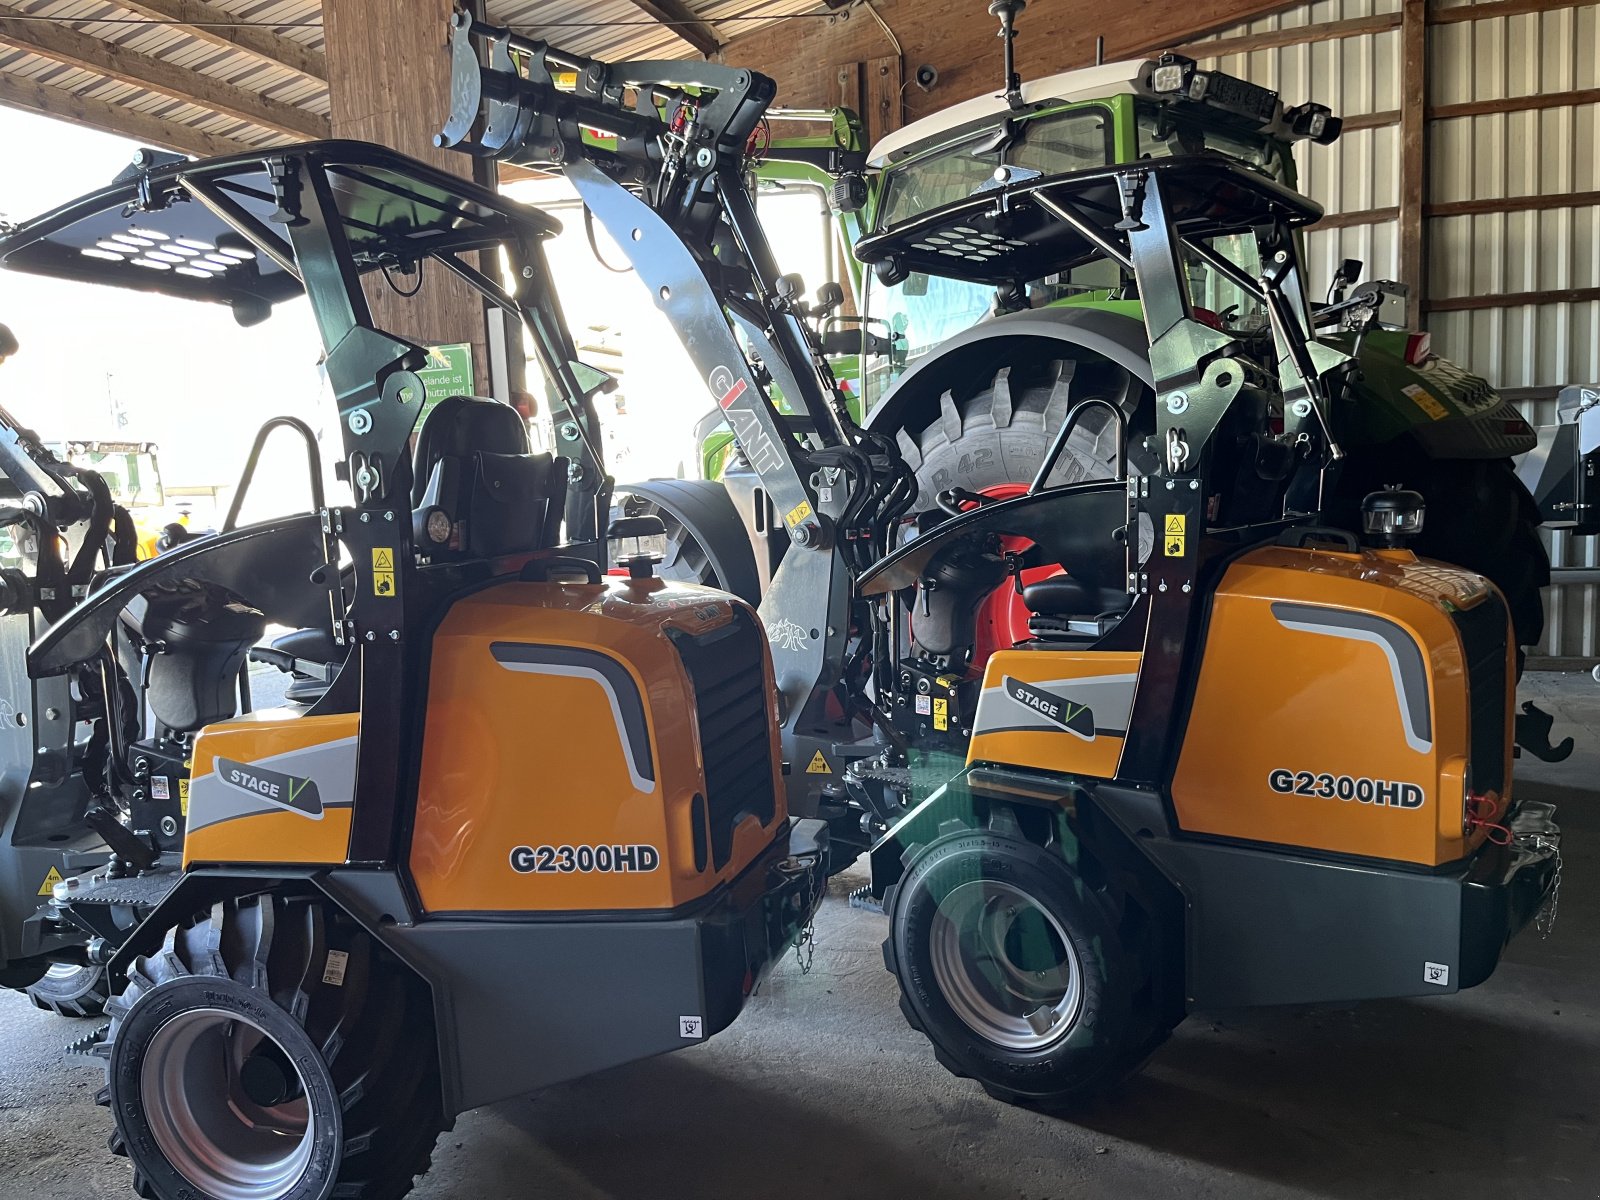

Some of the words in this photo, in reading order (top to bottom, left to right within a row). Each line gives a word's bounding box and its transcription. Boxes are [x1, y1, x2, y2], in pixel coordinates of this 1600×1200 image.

[425, 354, 453, 369] UNG
[449, 385, 466, 396] und
[452, 374, 463, 384] ist
[708, 365, 785, 476] GIANT
[957, 448, 994, 474] 42
[1015, 688, 1059, 718] STAGE
[1065, 702, 1088, 723] V
[230, 769, 280, 798] STAGE
[288, 776, 311, 803] V
[1267, 768, 1425, 810] G2300HD
[509, 844, 660, 873] G2300HD
